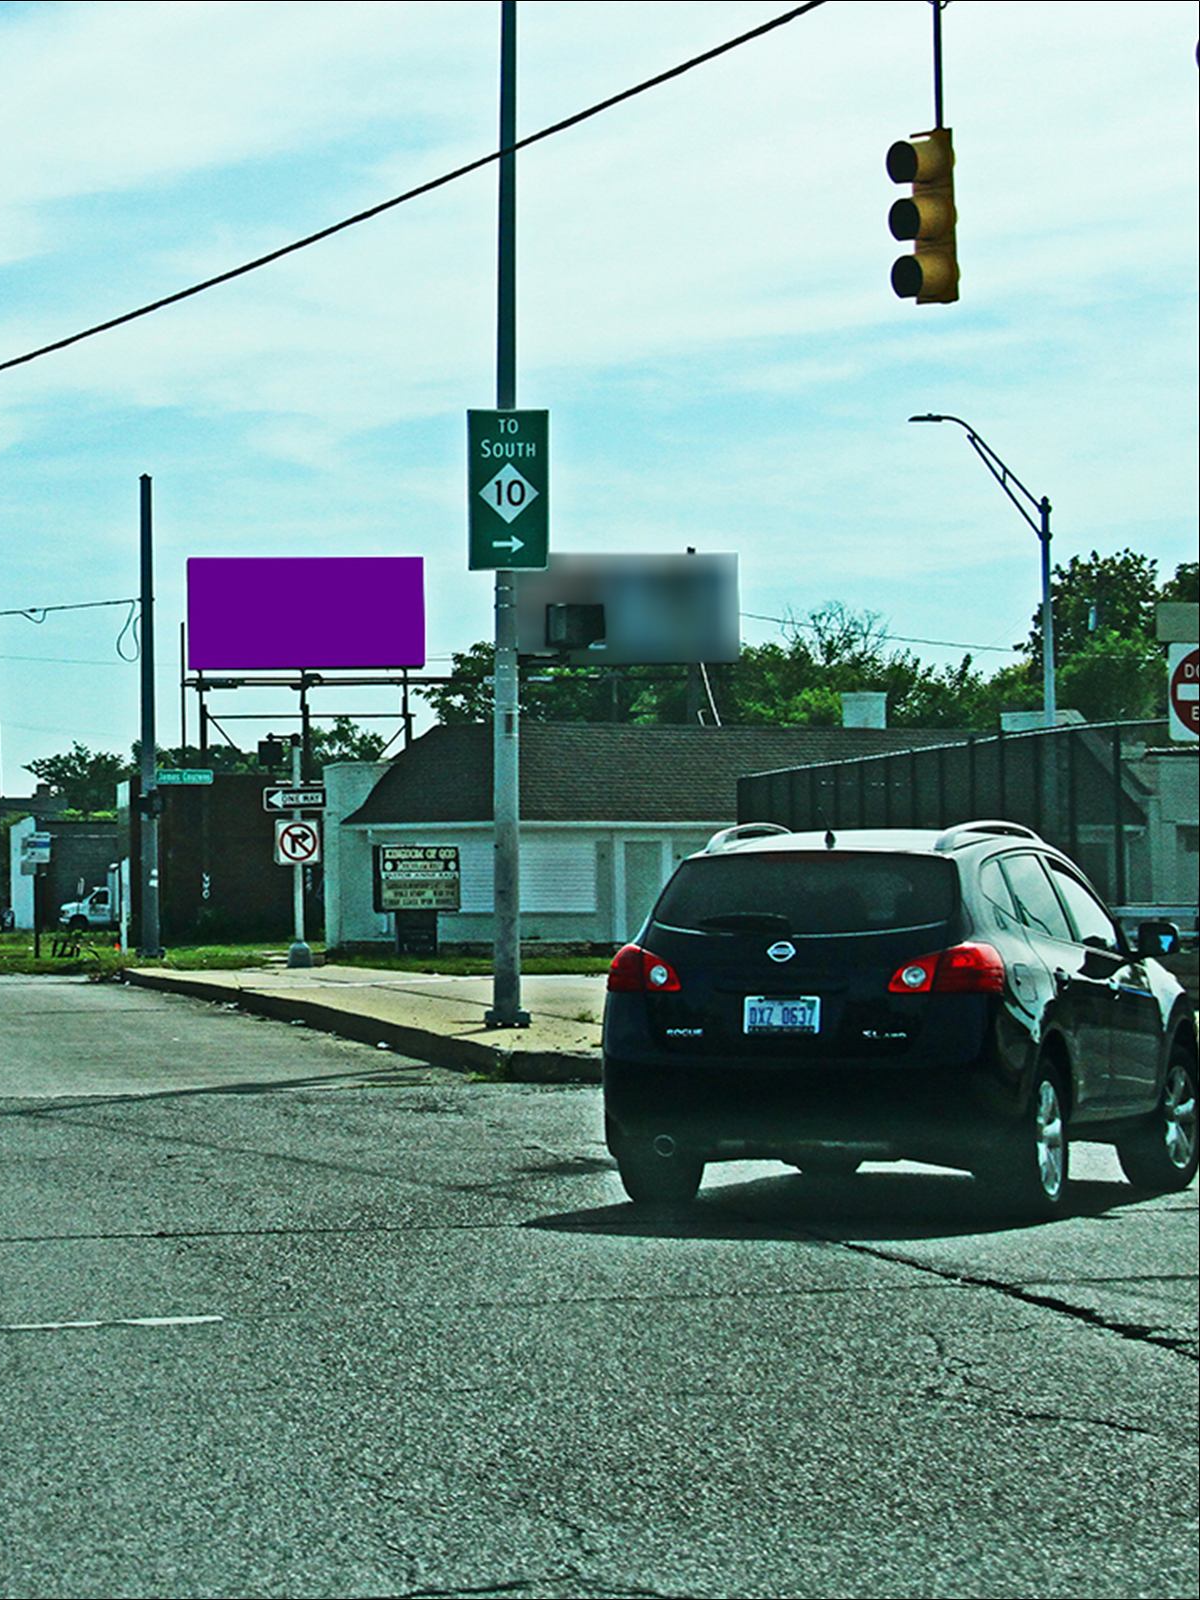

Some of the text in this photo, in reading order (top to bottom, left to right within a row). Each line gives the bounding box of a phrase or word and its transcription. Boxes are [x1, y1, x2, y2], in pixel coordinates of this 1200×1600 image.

[498, 418, 519, 434] TO
[480, 438, 536, 458] SOUTH
[494, 479, 526, 507] 10
[281, 794, 320, 803] ONE WAY
[781, 1006, 815, 1025] 0637
